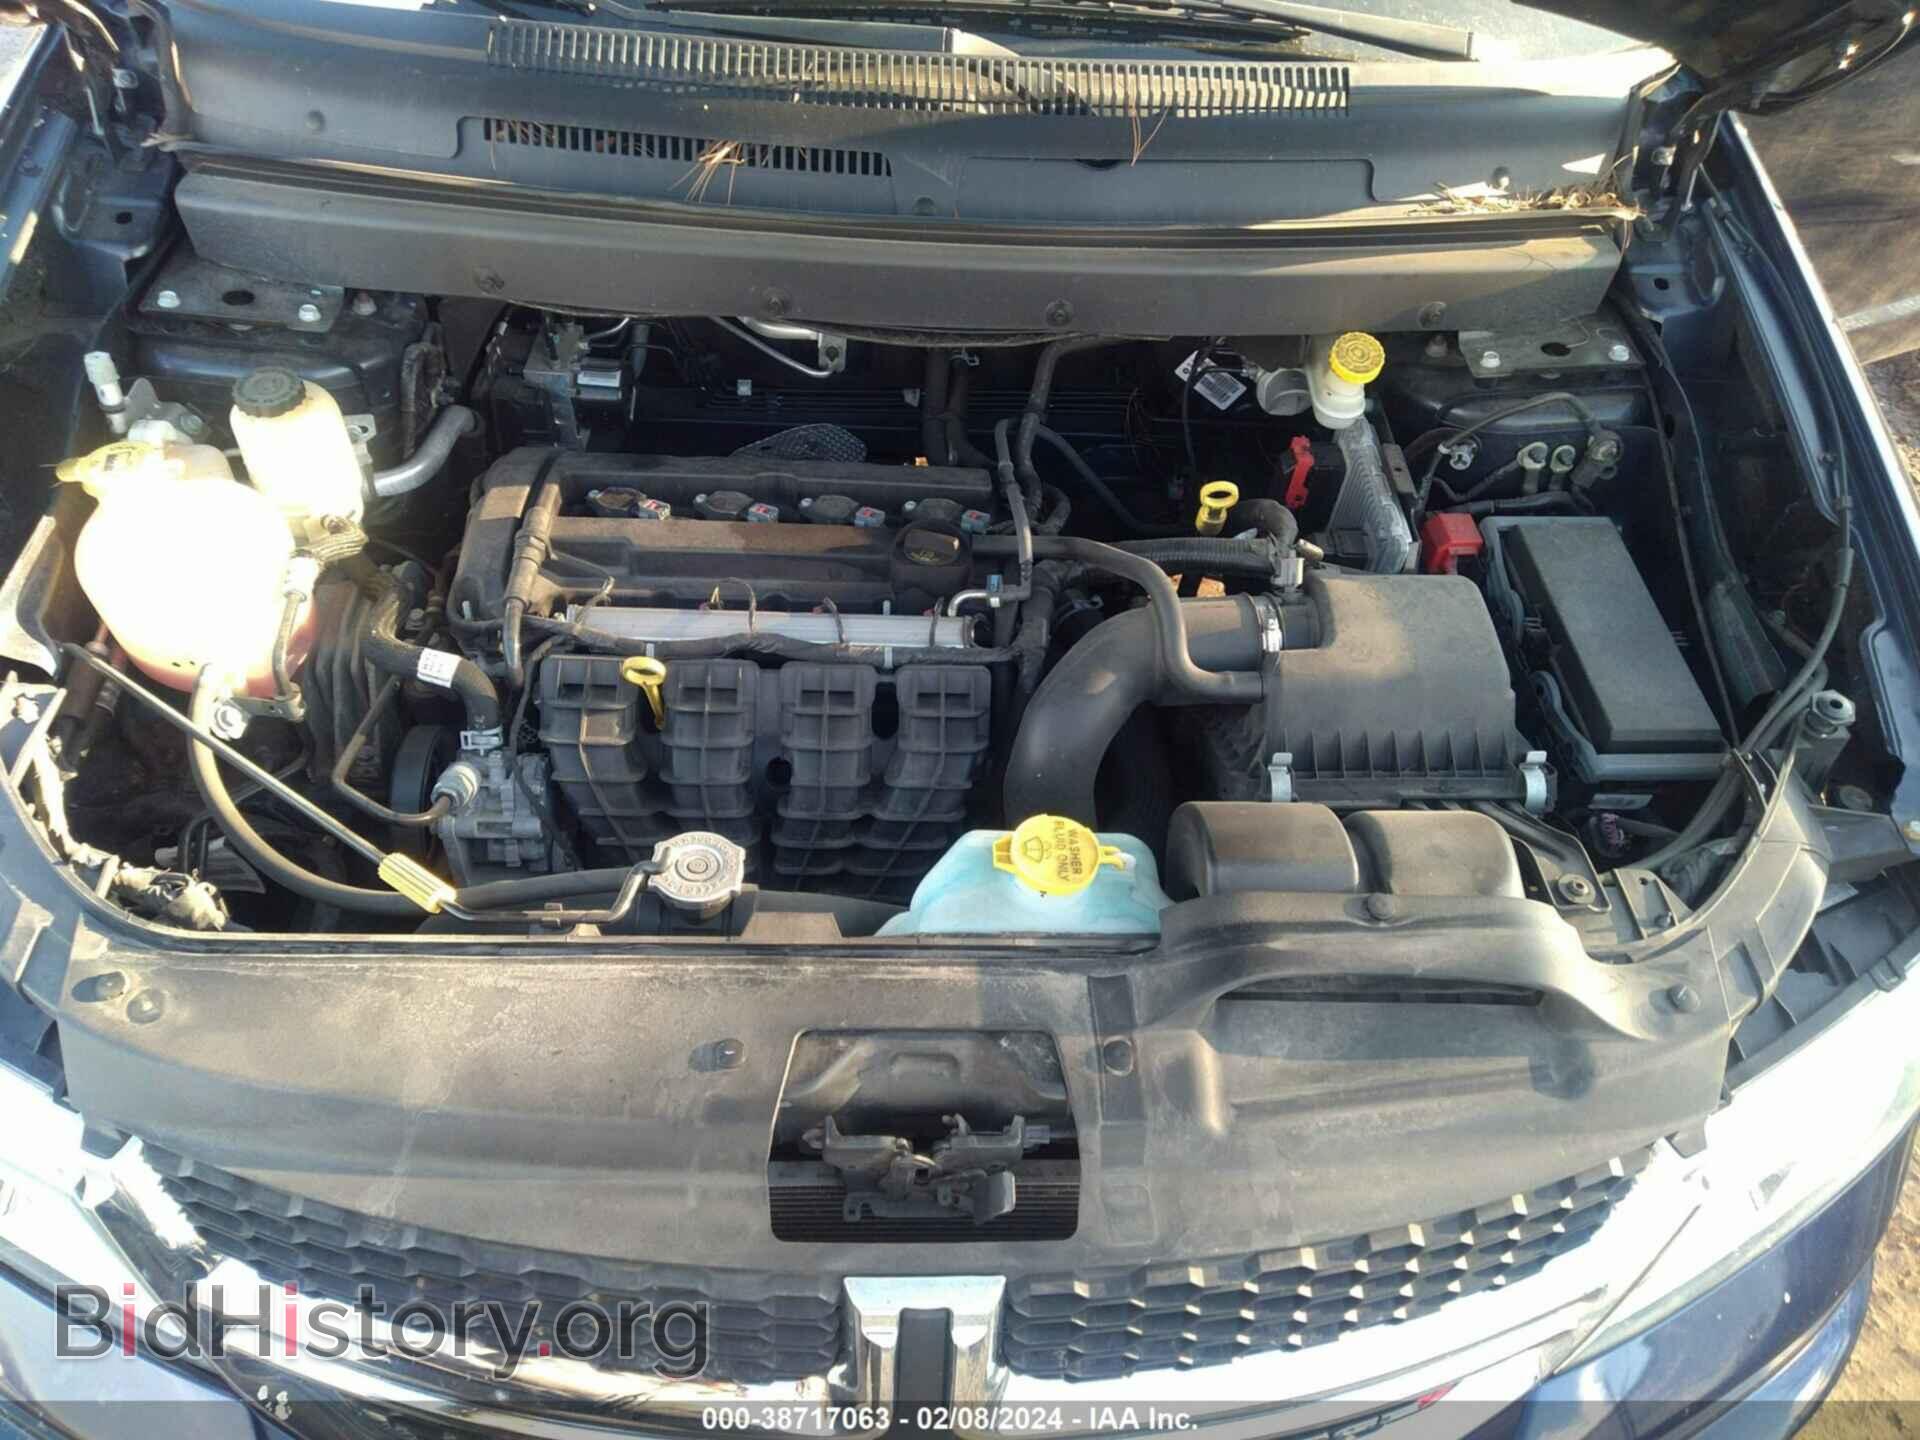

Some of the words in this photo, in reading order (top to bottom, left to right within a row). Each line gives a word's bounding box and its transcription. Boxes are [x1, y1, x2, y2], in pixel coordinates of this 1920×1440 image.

[1054, 821, 1066, 851] FLUID
[1068, 829, 1083, 875] WASHER
[1057, 854, 1070, 882] ONLY
